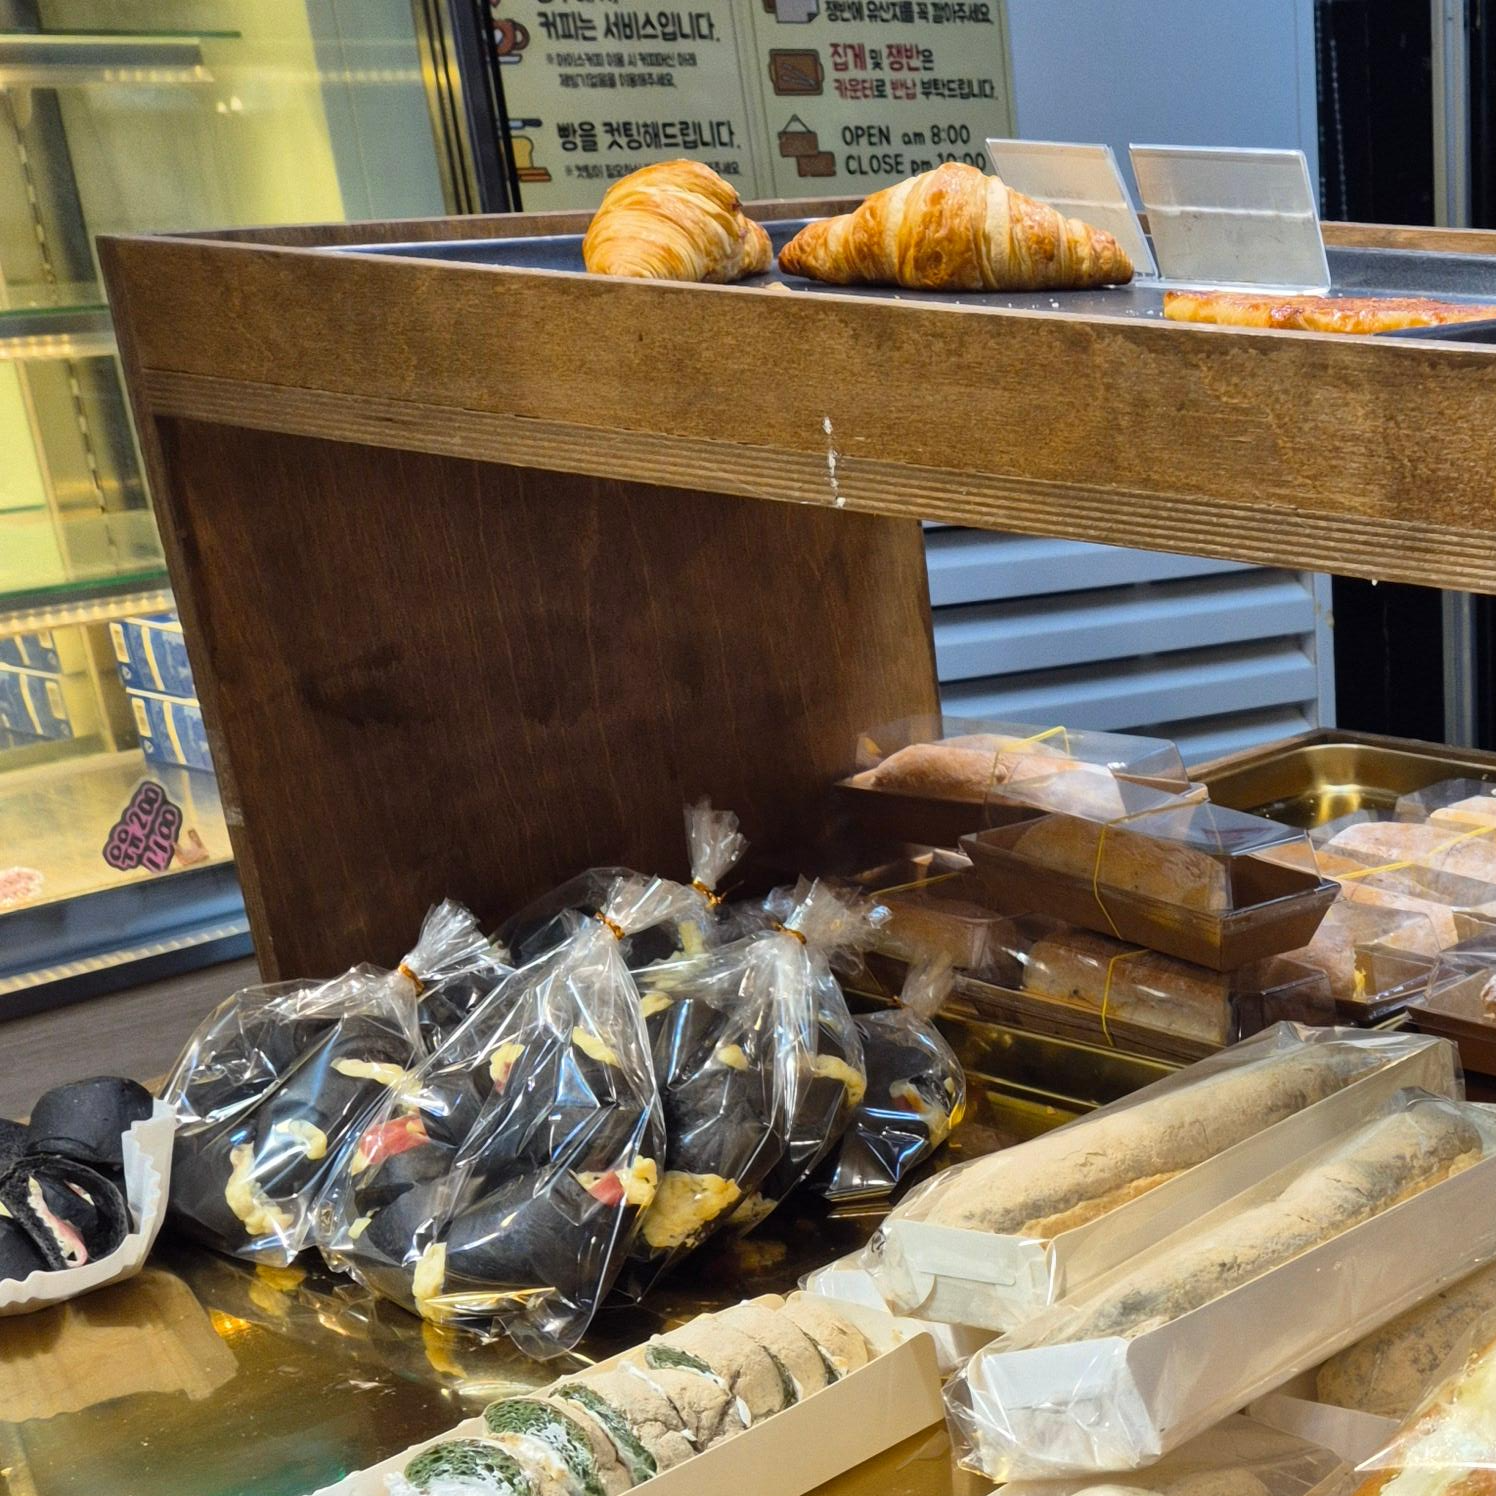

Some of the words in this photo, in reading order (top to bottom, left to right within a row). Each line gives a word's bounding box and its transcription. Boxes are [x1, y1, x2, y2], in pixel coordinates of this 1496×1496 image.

[538, 11, 598, 42] 커피는
[604, 11, 720, 42] 서비스입니다.
[829, 43, 867, 72] 집게
[869, 49, 883, 71] 및
[886, 43, 934, 72] 쟁반은
[833, 78, 888, 100] 카운터로
[890, 78, 917, 100] 반납
[556, 121, 598, 152] 빵을
[842, 124, 891, 146] OPEN
[902, 131, 925, 146] am
[930, 123, 971, 146] 8:00
[845, 153, 904, 176] CLOSE
[911, 158, 933, 176] pm
